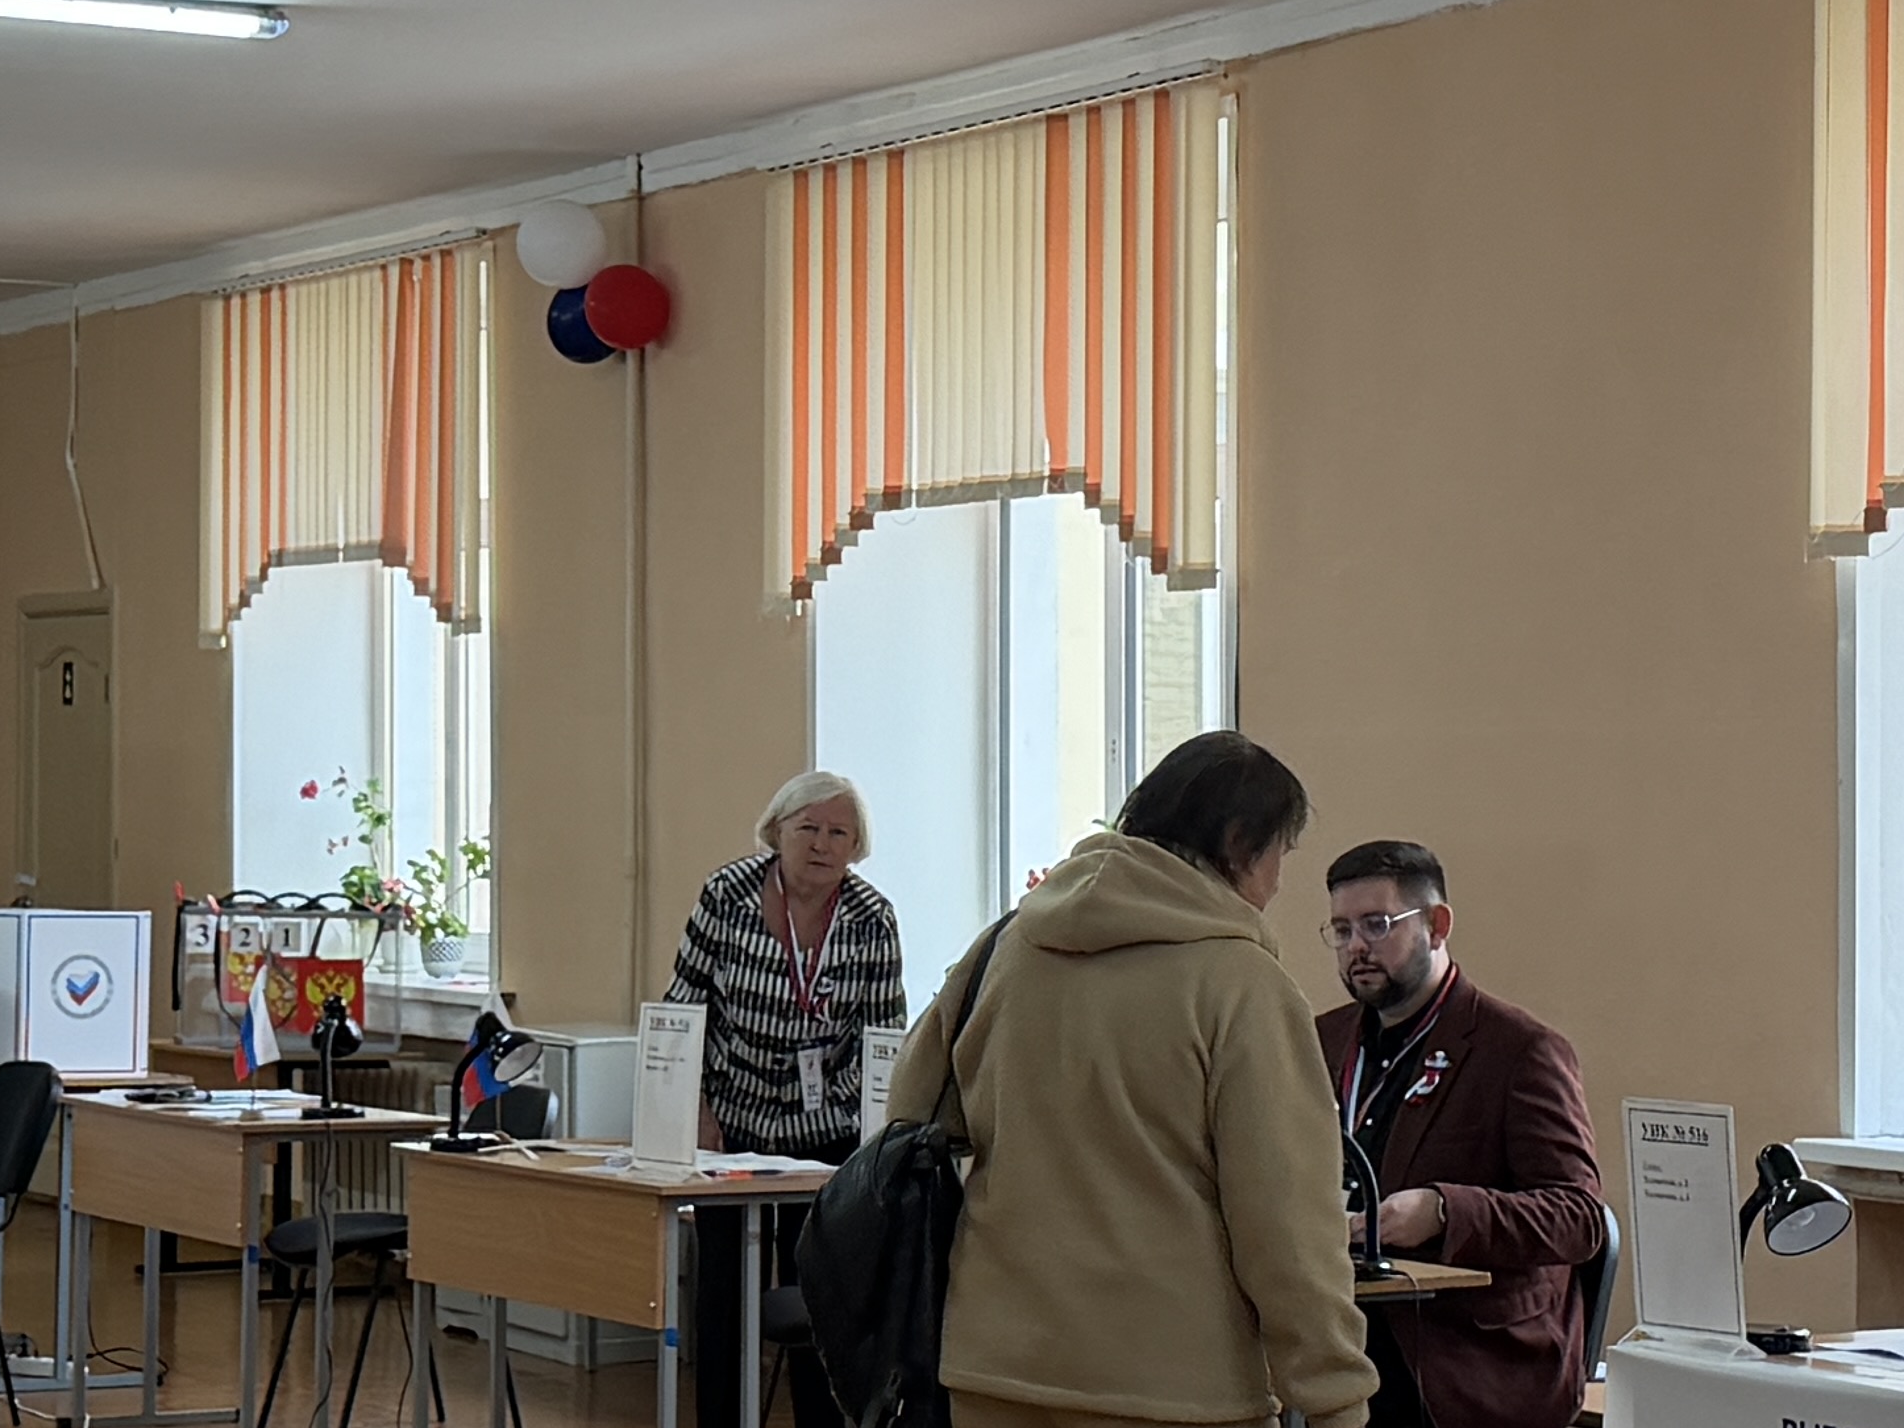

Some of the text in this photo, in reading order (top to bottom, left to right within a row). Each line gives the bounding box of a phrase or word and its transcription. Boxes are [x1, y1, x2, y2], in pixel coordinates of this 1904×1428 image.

[195, 924, 209, 947] 3
[239, 928, 252, 947] 2
[283, 928, 290, 947] 1
[1641, 1122, 1669, 1139] УИК
[1689, 1126, 1709, 1142] 516
